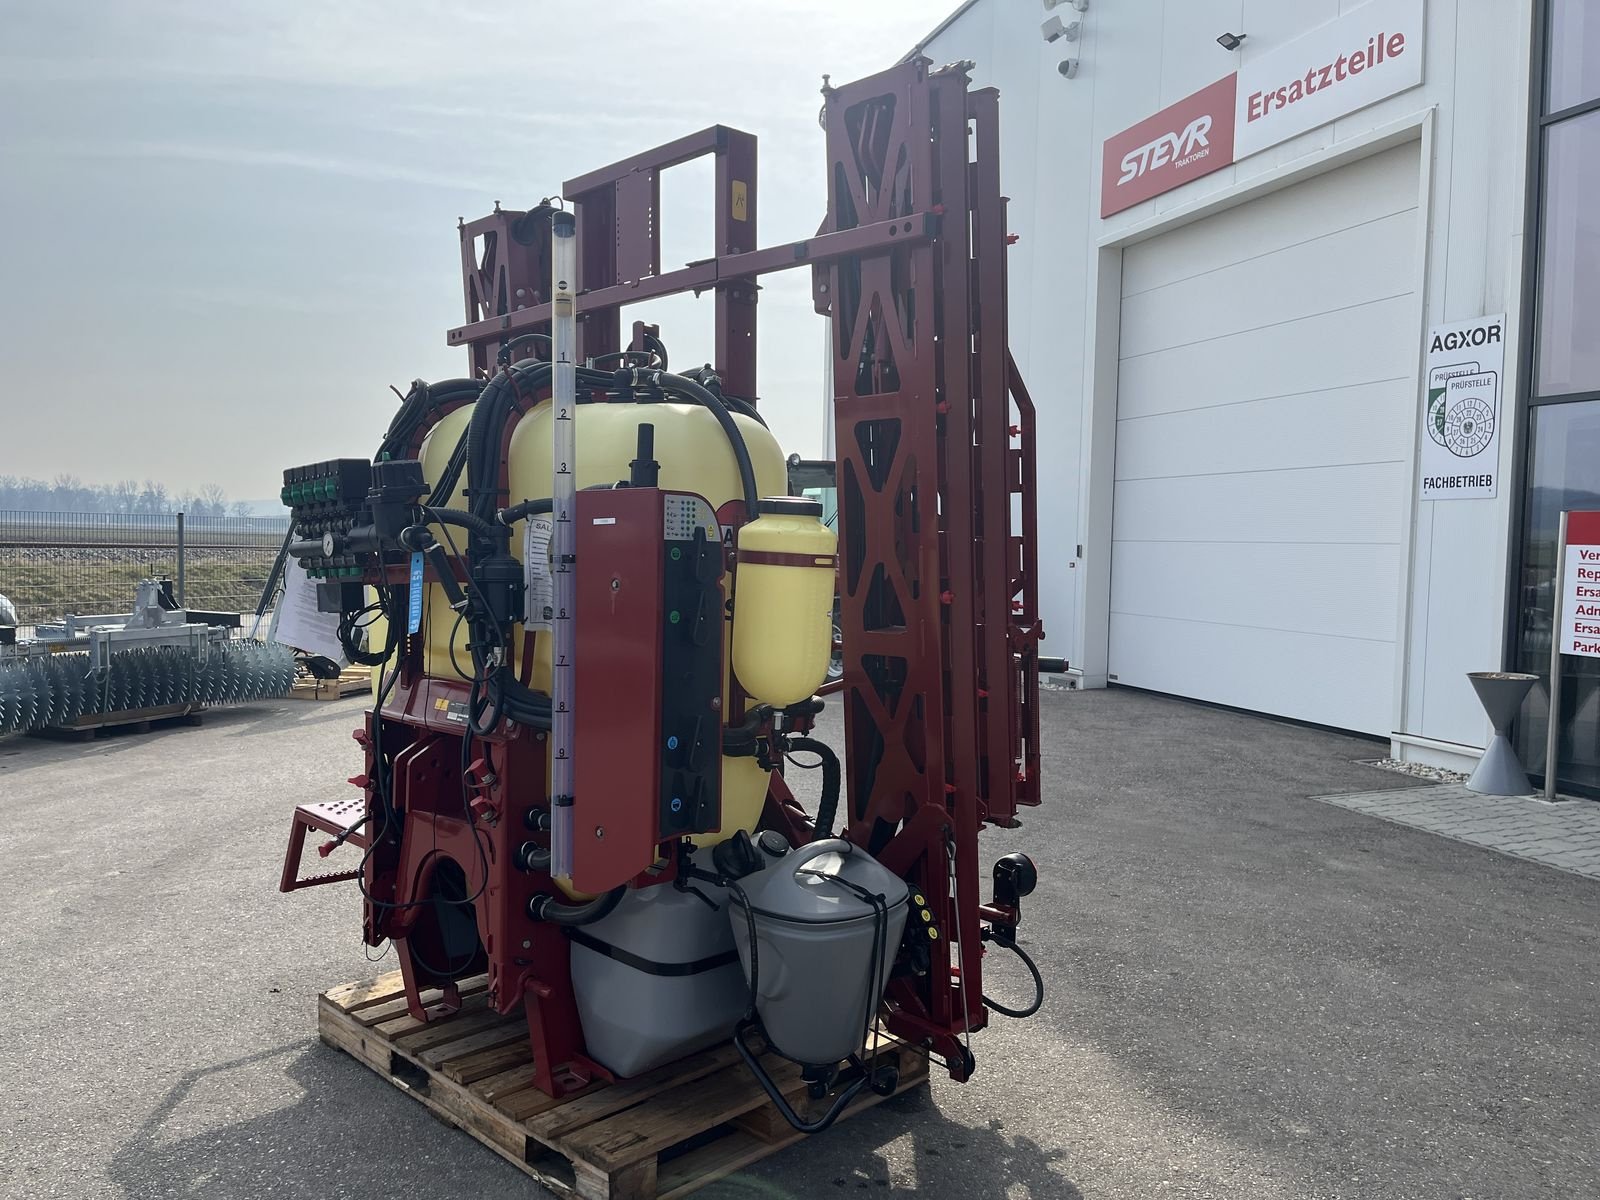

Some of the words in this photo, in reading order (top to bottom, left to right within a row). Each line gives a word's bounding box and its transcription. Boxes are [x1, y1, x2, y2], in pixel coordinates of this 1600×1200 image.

[1247, 32, 1405, 123] Ersatzteile
[1117, 114, 1213, 186] STEYR
[1174, 147, 1211, 169] TRAKTOREN
[1430, 324, 1501, 353] AGXOR
[561, 351, 565, 360] 1
[1451, 377, 1492, 390] PRÜFSTELLE
[561, 408, 567, 418] 2
[561, 462, 567, 472] 3
[1423, 474, 1493, 489] FACHBETRIEB
[561, 510, 567, 520] 4
[1580, 549, 1600, 560] Ver
[560, 562, 566, 572] 5
[1578, 567, 1600, 581] Rep
[1576, 586, 1600, 597] Ersa
[560, 608, 566, 617] 6
[1574, 622, 1600, 634] Ersa
[559, 655, 566, 665] 7
[559, 701, 565, 711] 8
[559, 748, 565, 758] 9
